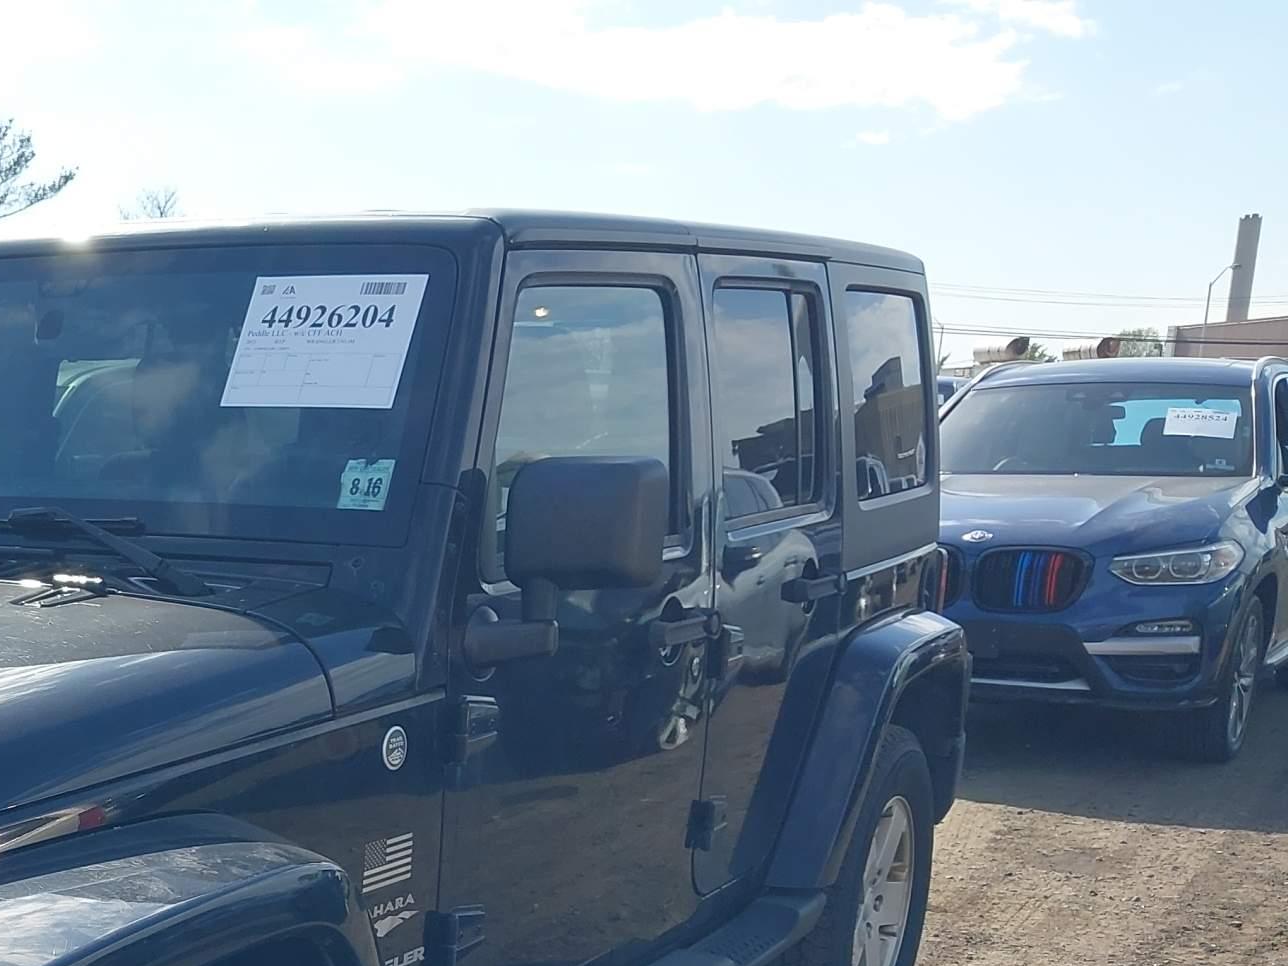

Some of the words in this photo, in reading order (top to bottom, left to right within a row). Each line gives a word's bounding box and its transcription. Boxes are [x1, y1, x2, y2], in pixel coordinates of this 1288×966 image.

[261, 304, 397, 328] 44926204
[349, 478, 361, 496] 8
[363, 477, 383, 498] 16
